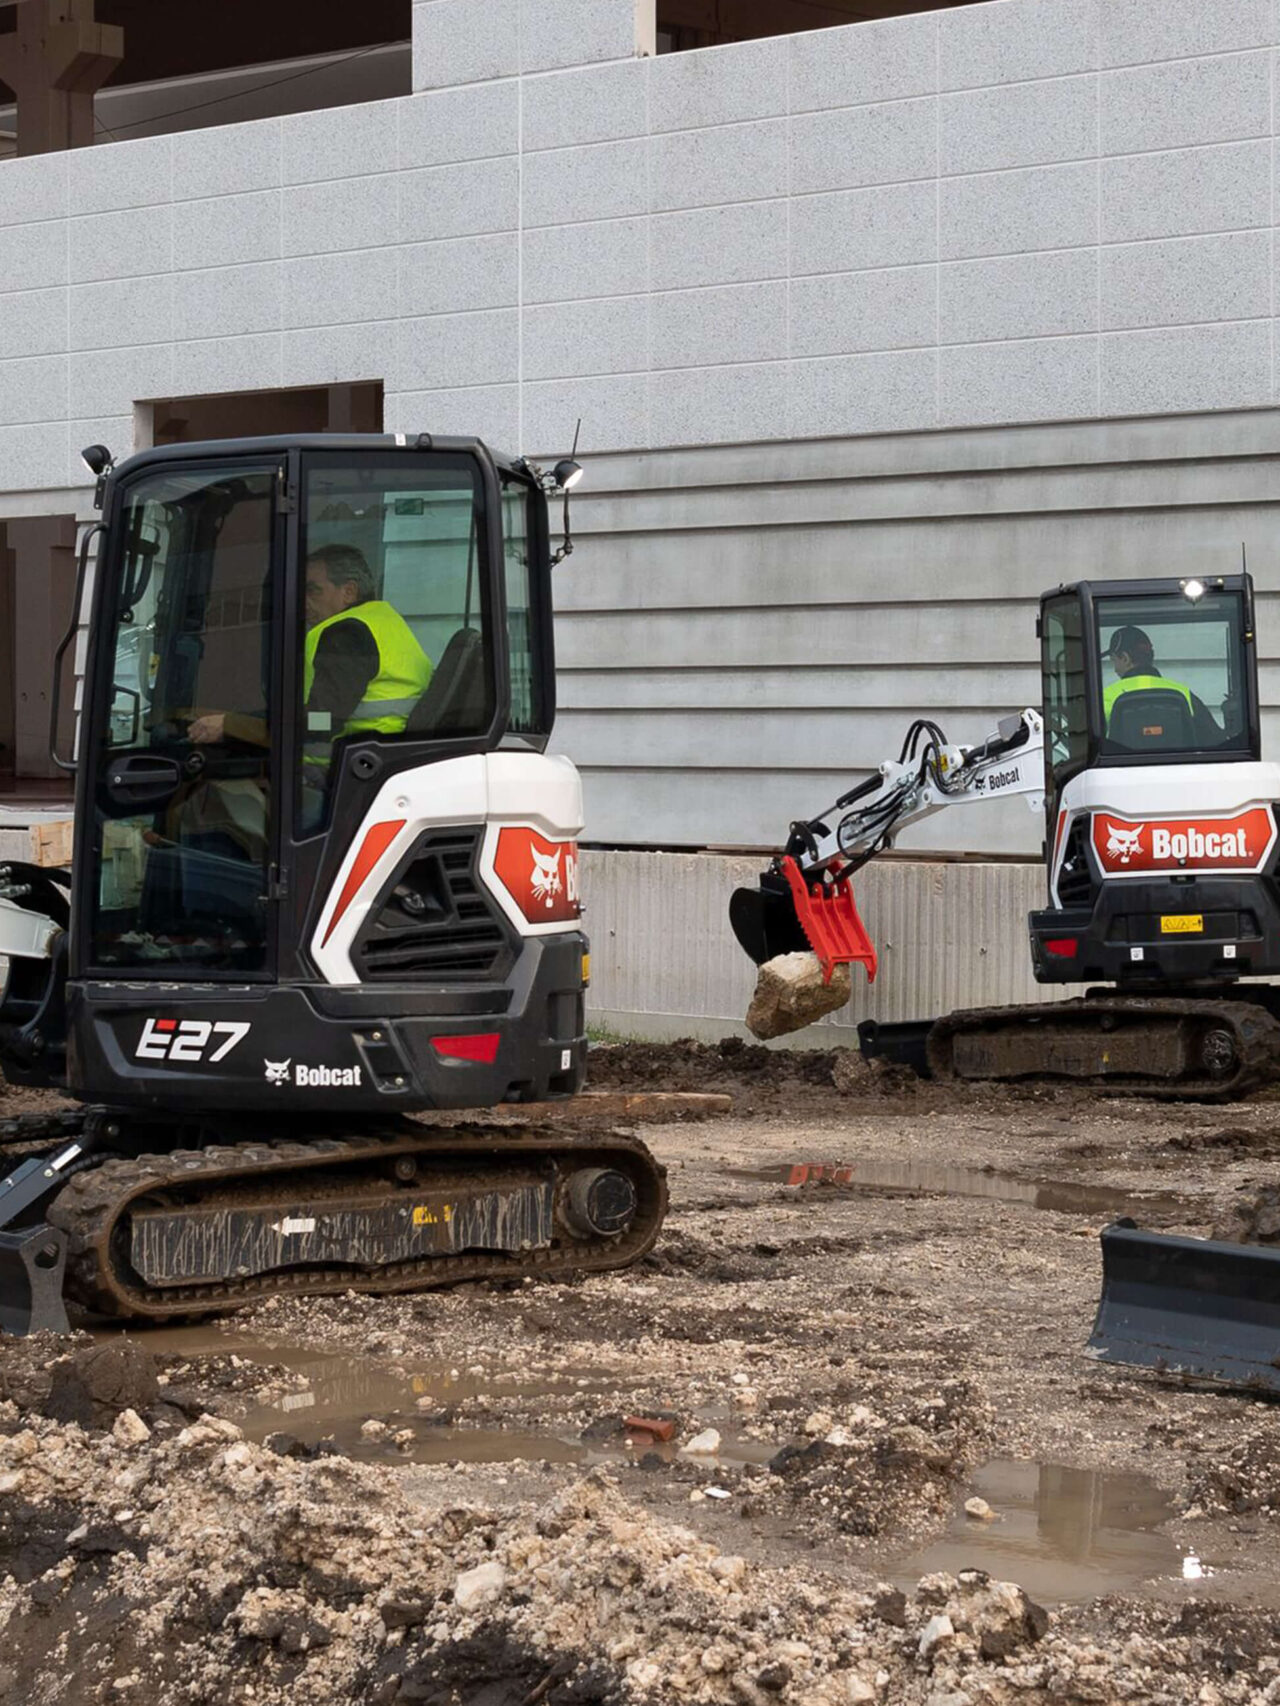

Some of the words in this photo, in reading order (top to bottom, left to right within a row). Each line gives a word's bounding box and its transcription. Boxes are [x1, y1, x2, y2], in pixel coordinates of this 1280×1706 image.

[989, 767, 1020, 790] Bobcat
[1152, 828, 1247, 859] Bobcat
[135, 1018, 251, 1062] E27
[295, 1065, 362, 1087] Bobcat
